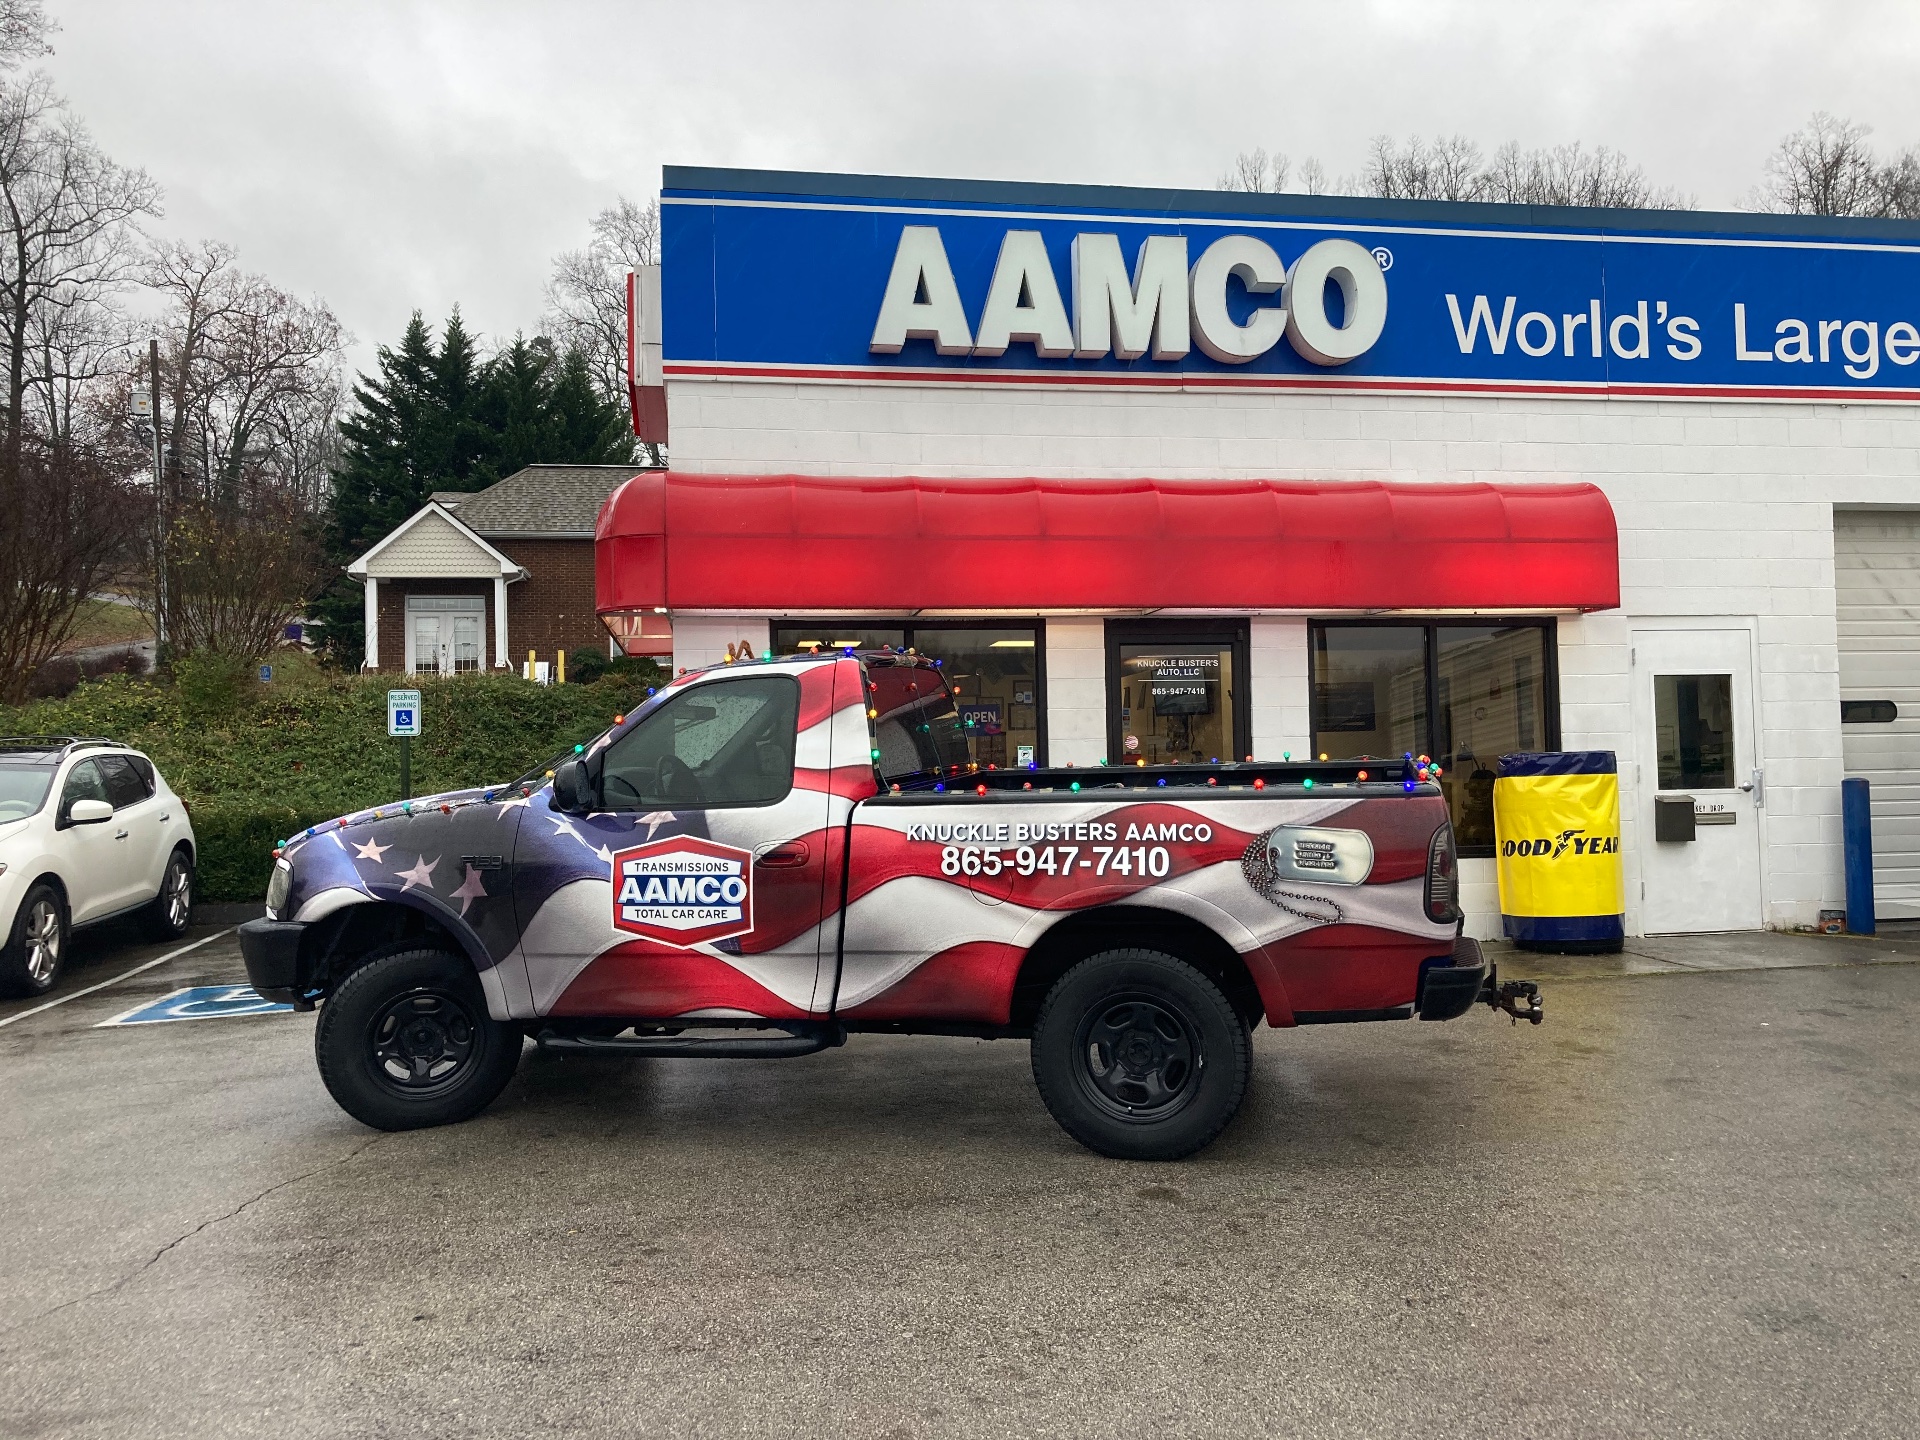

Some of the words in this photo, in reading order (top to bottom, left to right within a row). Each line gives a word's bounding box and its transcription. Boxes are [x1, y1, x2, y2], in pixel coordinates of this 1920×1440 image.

[1445, 293, 1702, 361] World's
[1734, 303, 1920, 379] Large
[1157, 669, 1182, 677] AUTO,
[963, 711, 997, 723] OPEN
[906, 823, 1008, 842] KNUCKLE
[1015, 823, 1117, 842] BUSTERS
[1124, 823, 1212, 842] AAMCO
[634, 862, 729, 872] TRANSMISSIONS
[940, 846, 1171, 877] 865-947-7410
[617, 876, 748, 905] AAMCO
[634, 909, 669, 919] TOTAL
[671, 909, 695, 919] CAR
[697, 909, 728, 919] CARE
